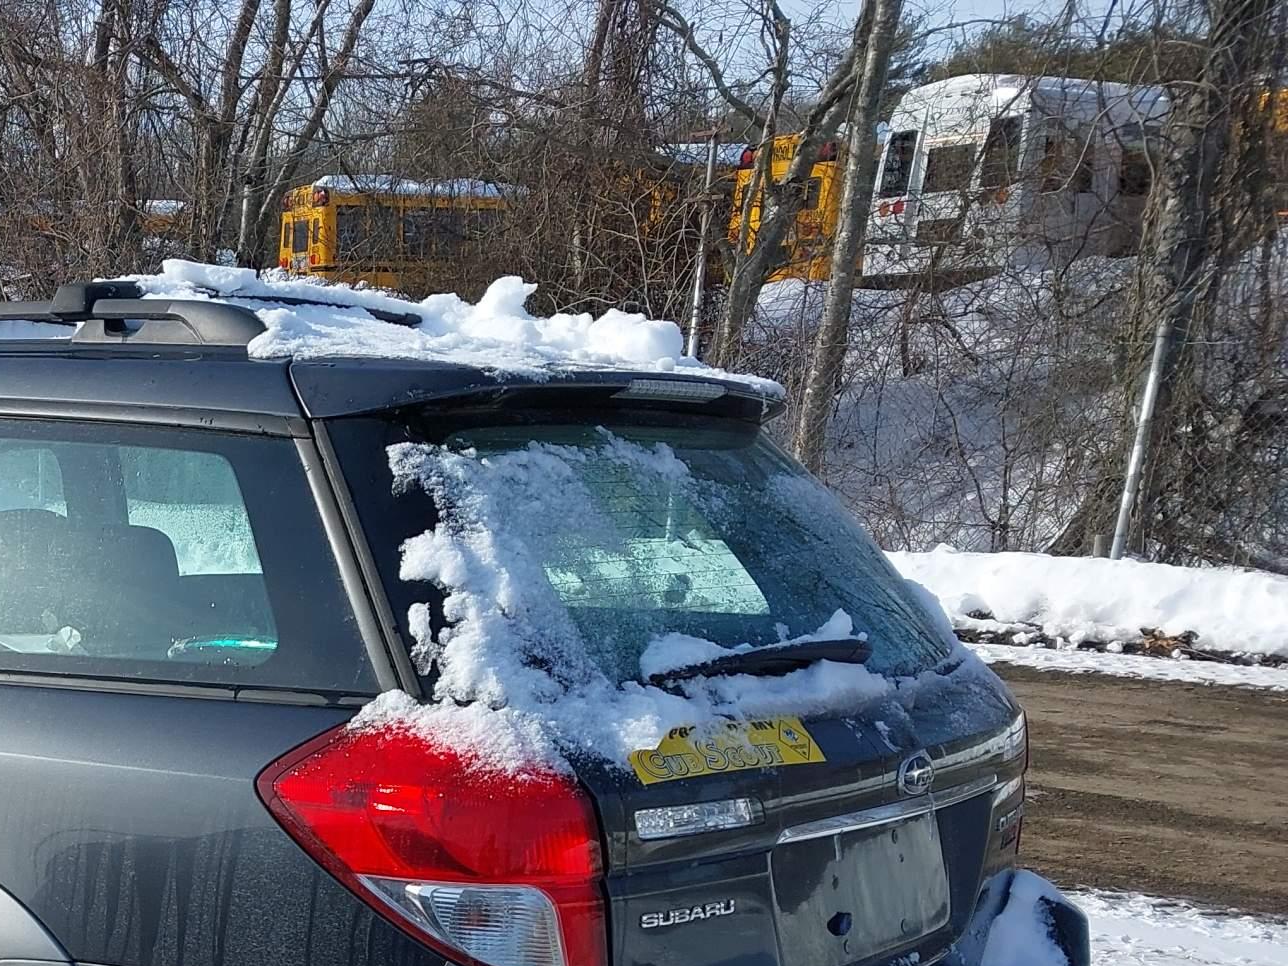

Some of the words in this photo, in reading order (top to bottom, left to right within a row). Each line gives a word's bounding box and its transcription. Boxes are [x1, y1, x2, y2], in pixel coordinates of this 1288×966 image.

[751, 719, 777, 732] MY
[637, 749, 704, 779] CUB
[695, 740, 785, 771] SCOUT
[640, 899, 735, 929] SUBARU
